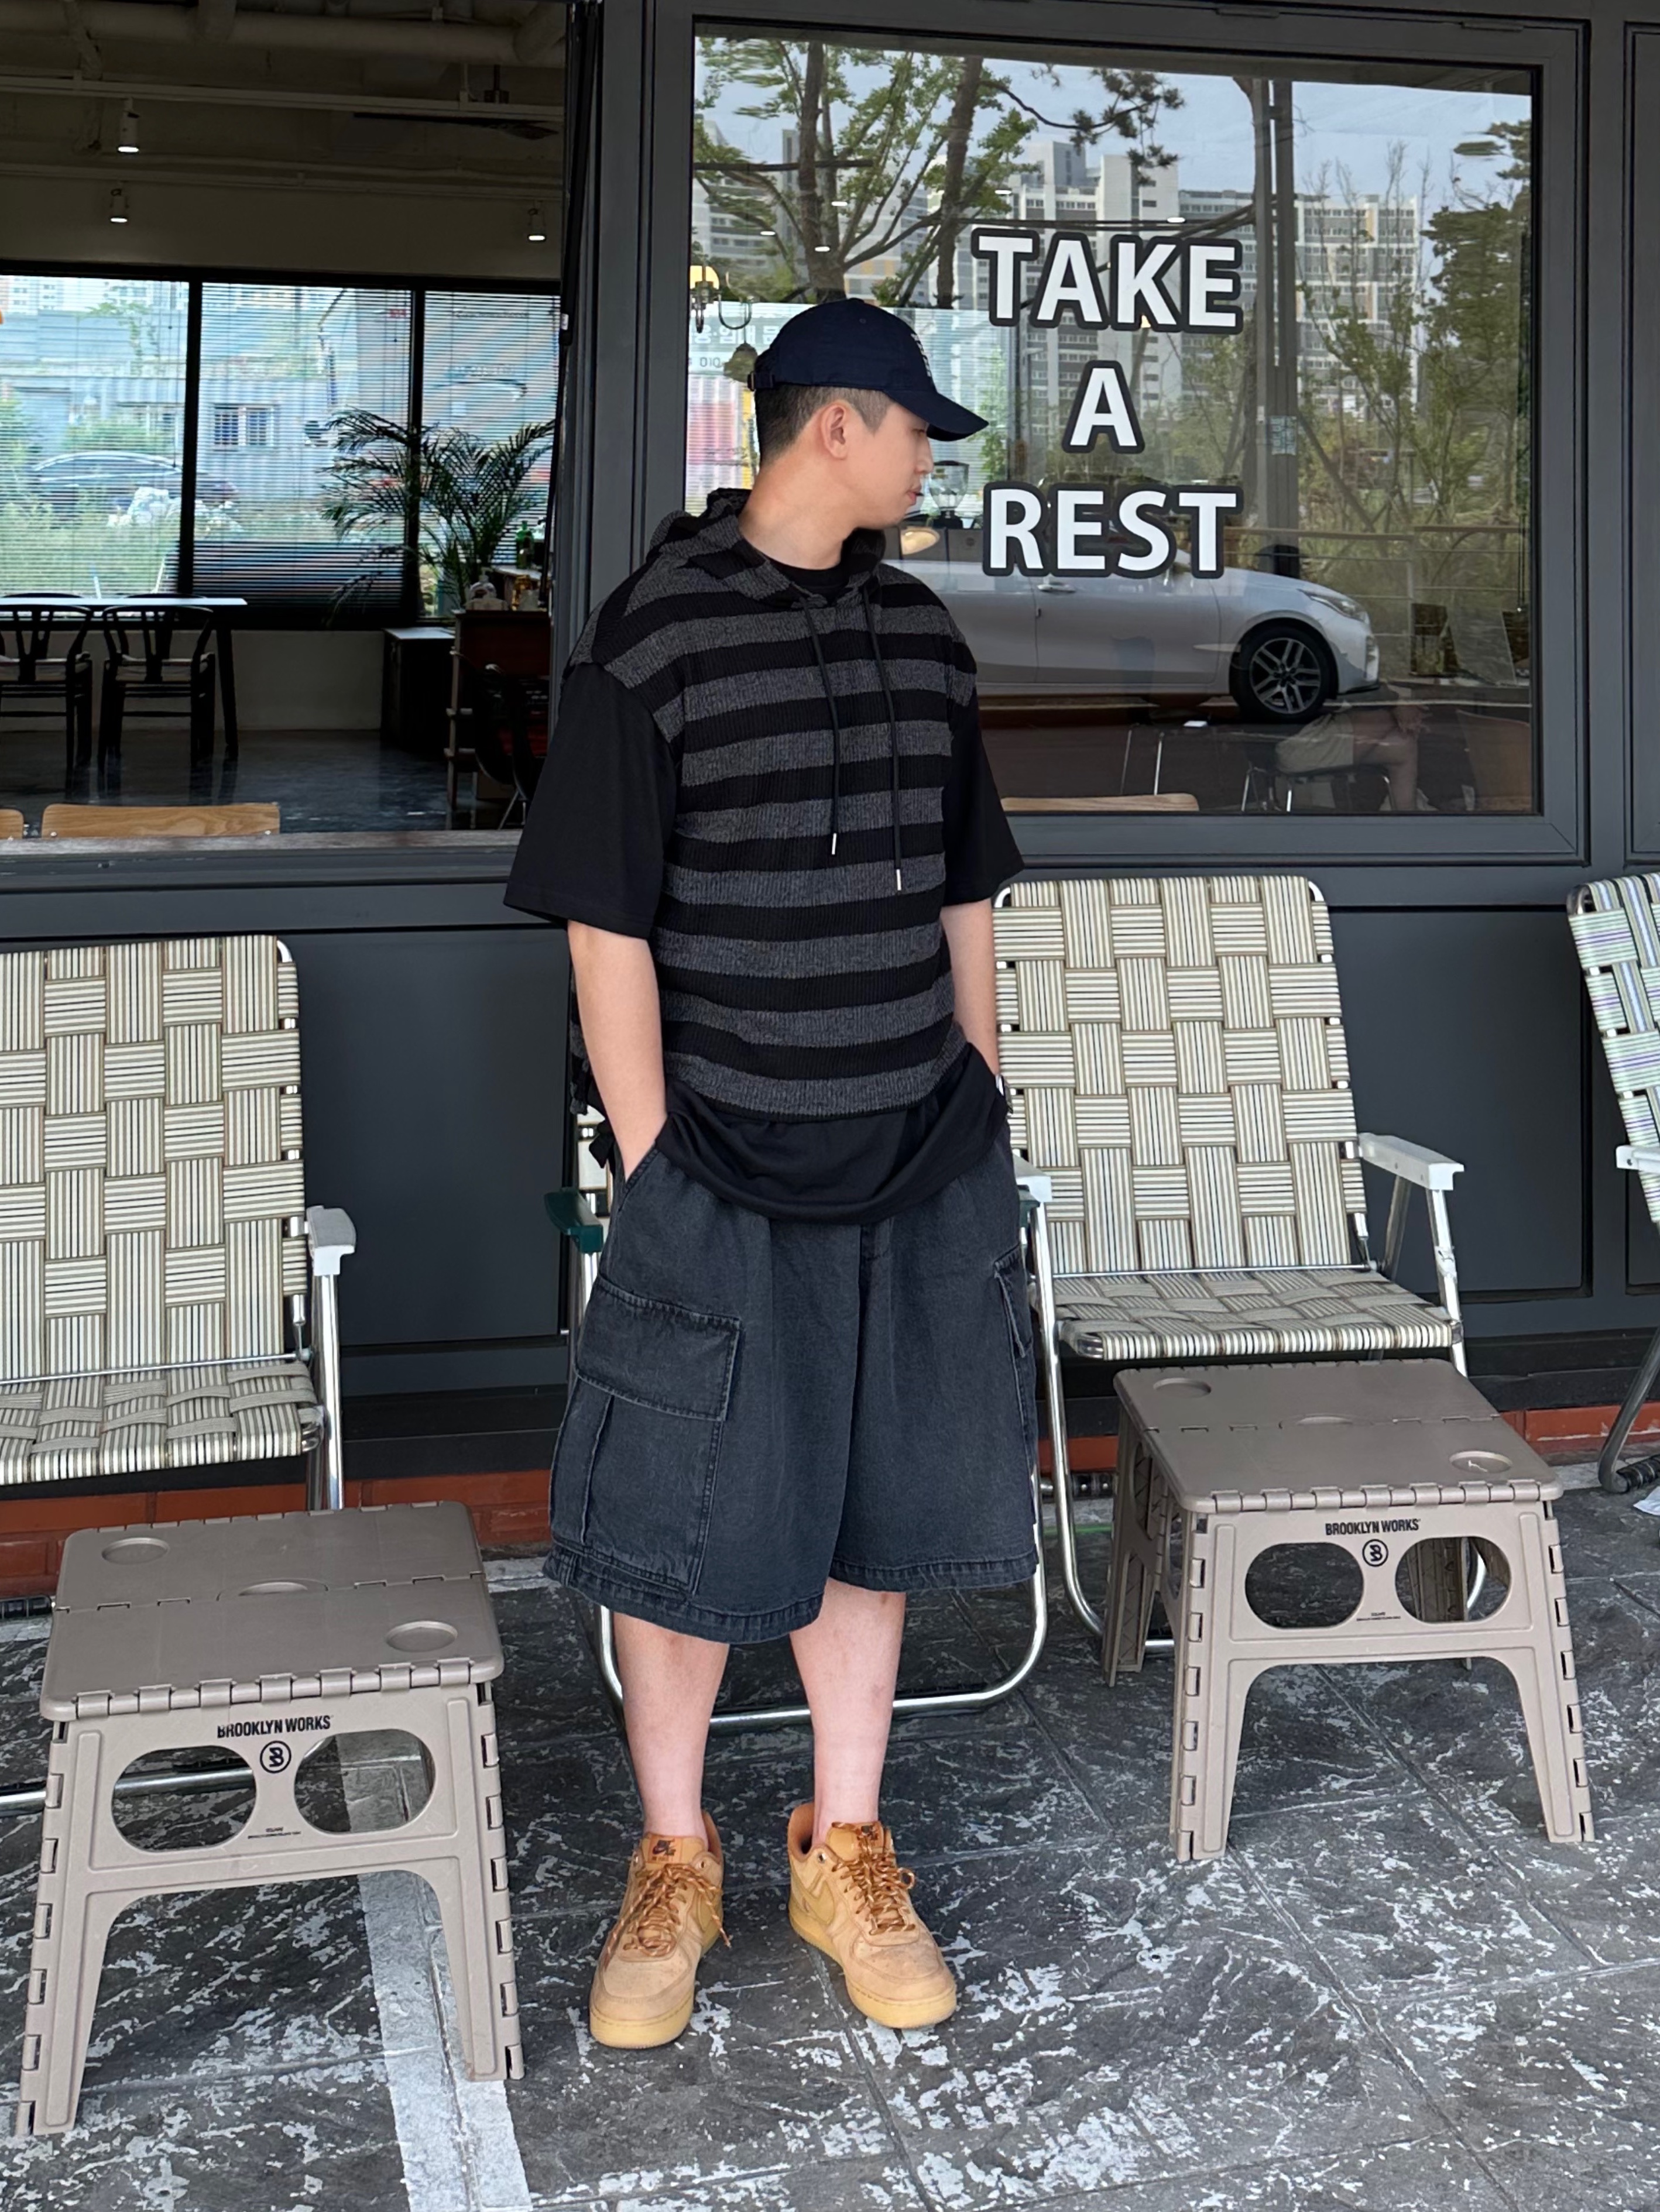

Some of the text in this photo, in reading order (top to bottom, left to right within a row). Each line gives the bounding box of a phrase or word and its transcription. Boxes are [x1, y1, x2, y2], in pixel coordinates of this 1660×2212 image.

[978, 235, 1236, 328] TAKE
[1069, 367, 1137, 446] A
[990, 489, 1237, 571] REST
[1325, 1518, 1419, 1536] BROOKLYN WORKS
[217, 1715, 331, 1739] BROOKLYN WORKS
